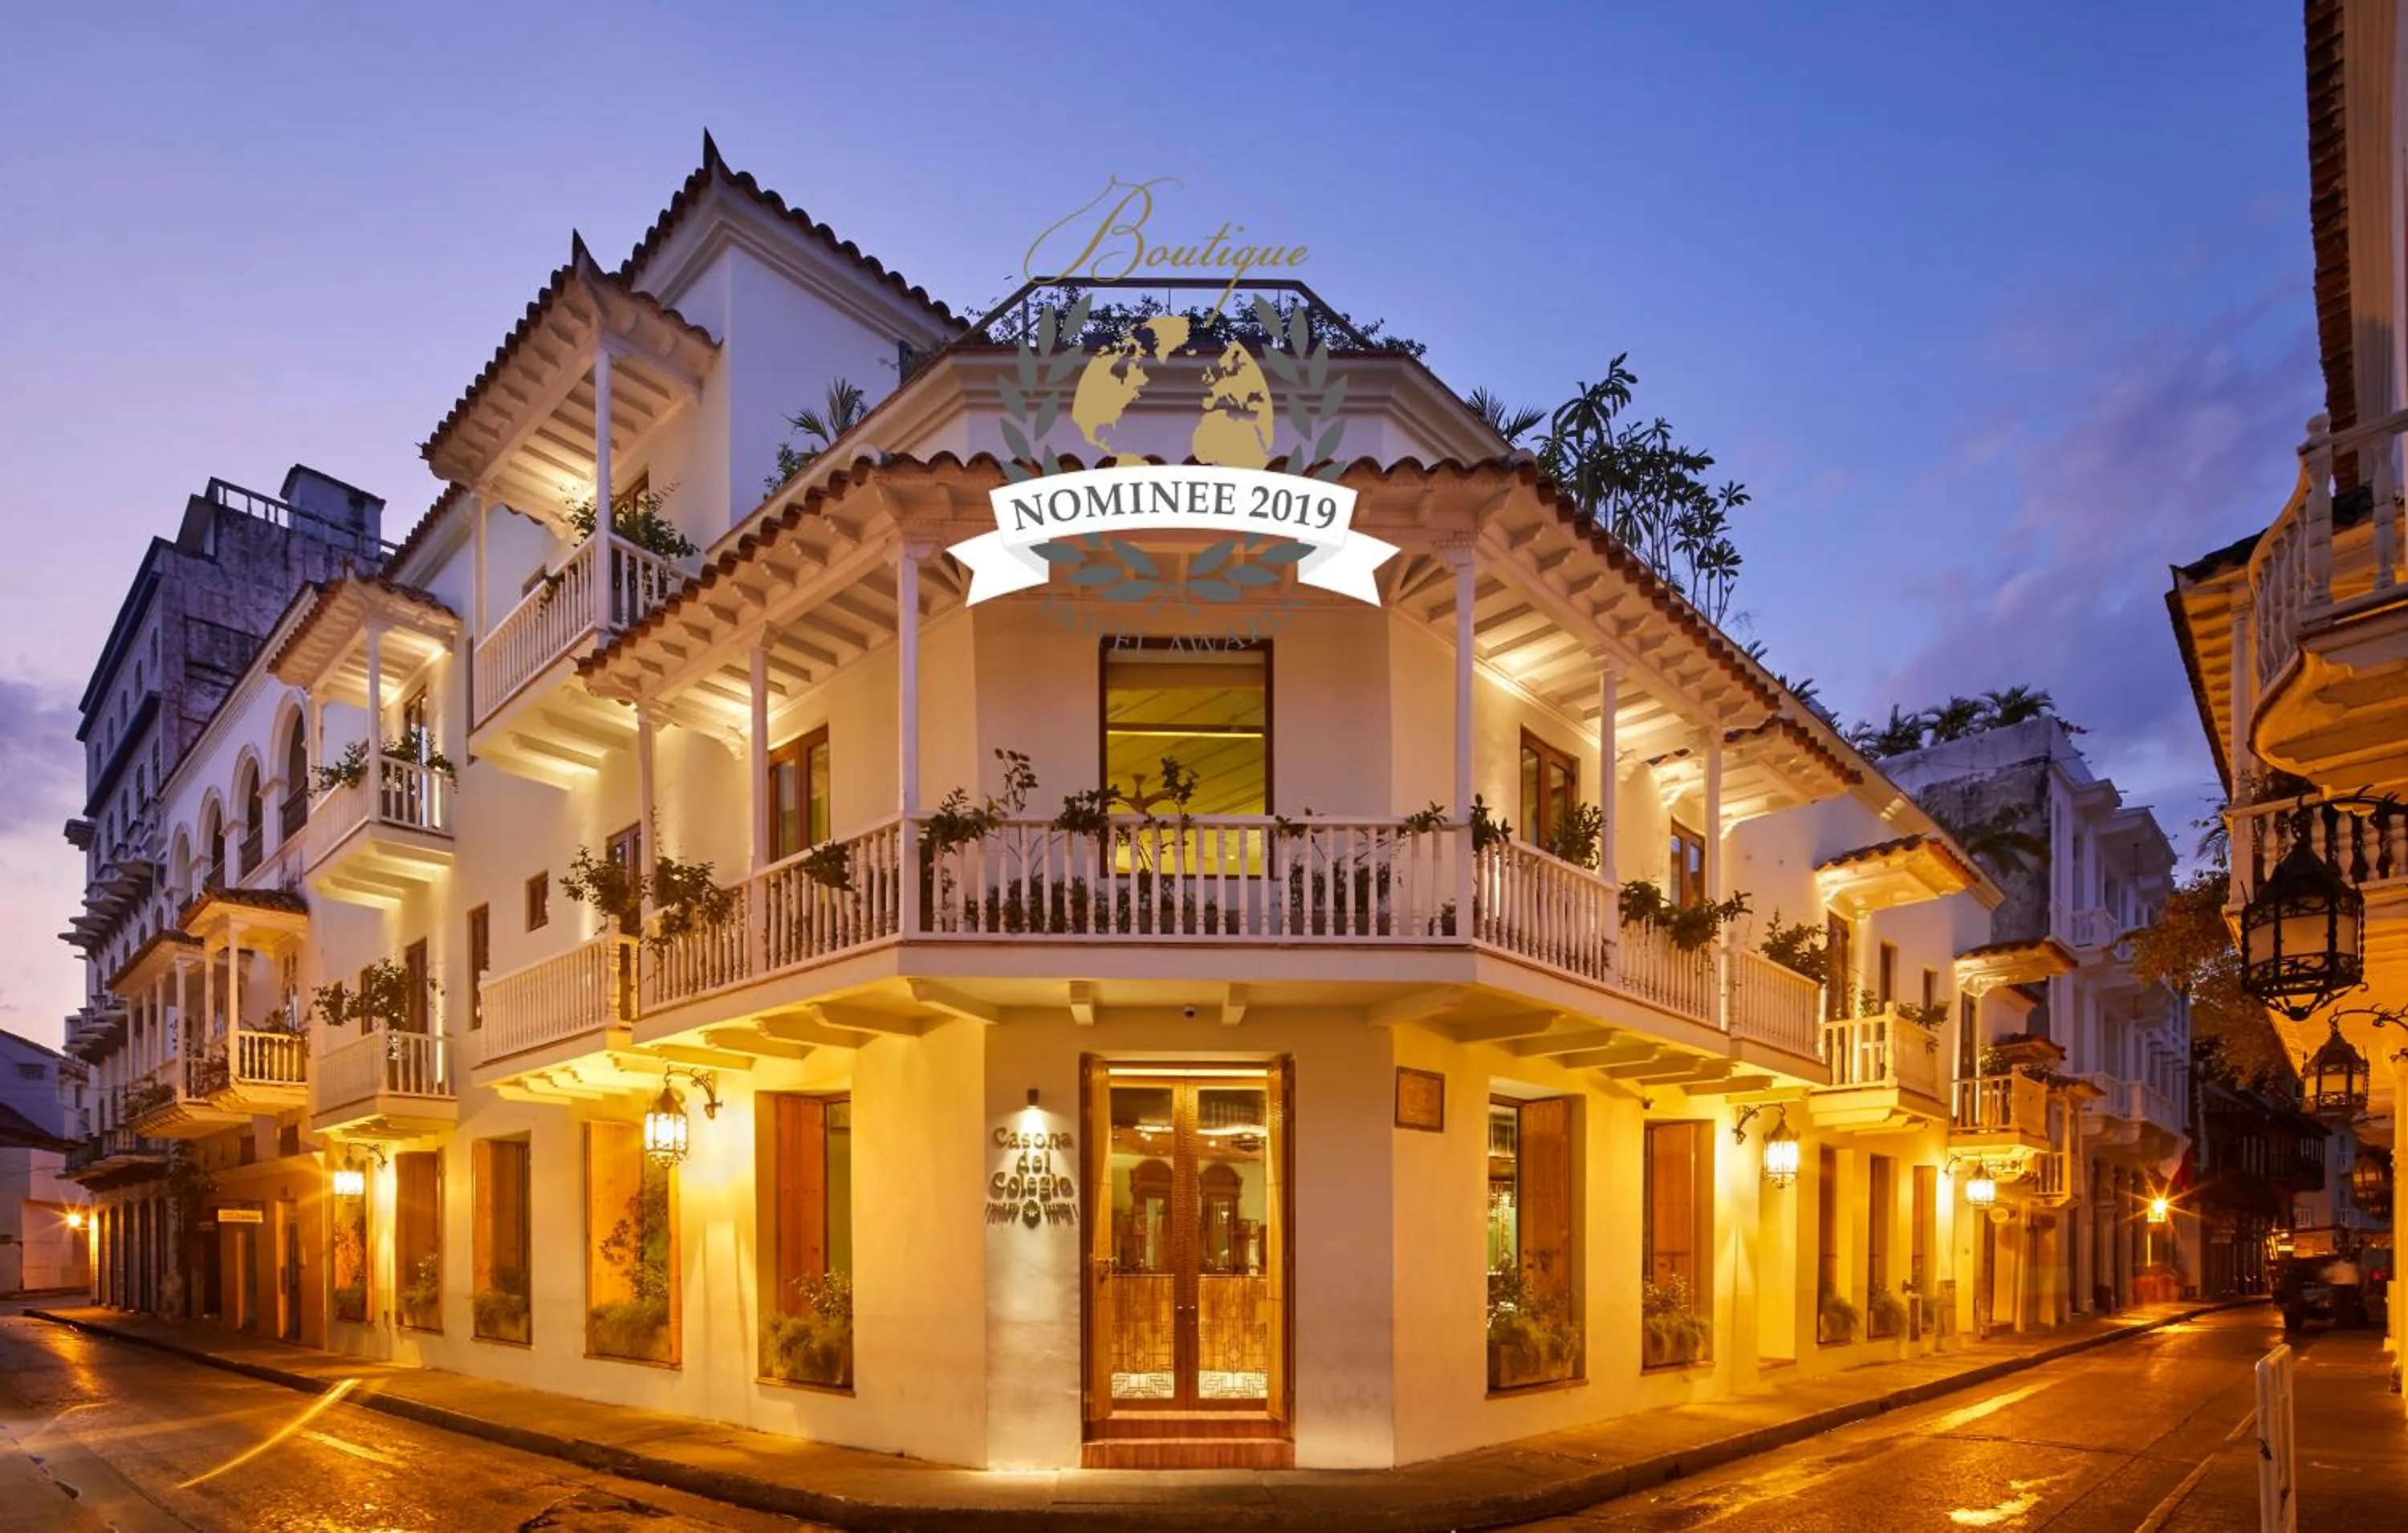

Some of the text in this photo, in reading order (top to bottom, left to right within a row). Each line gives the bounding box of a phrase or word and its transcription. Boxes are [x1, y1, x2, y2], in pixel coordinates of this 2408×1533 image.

[992, 1127, 1074, 1149] Casona
[1016, 1151, 1051, 1174] del
[990, 1172, 1074, 1201] Colegio
